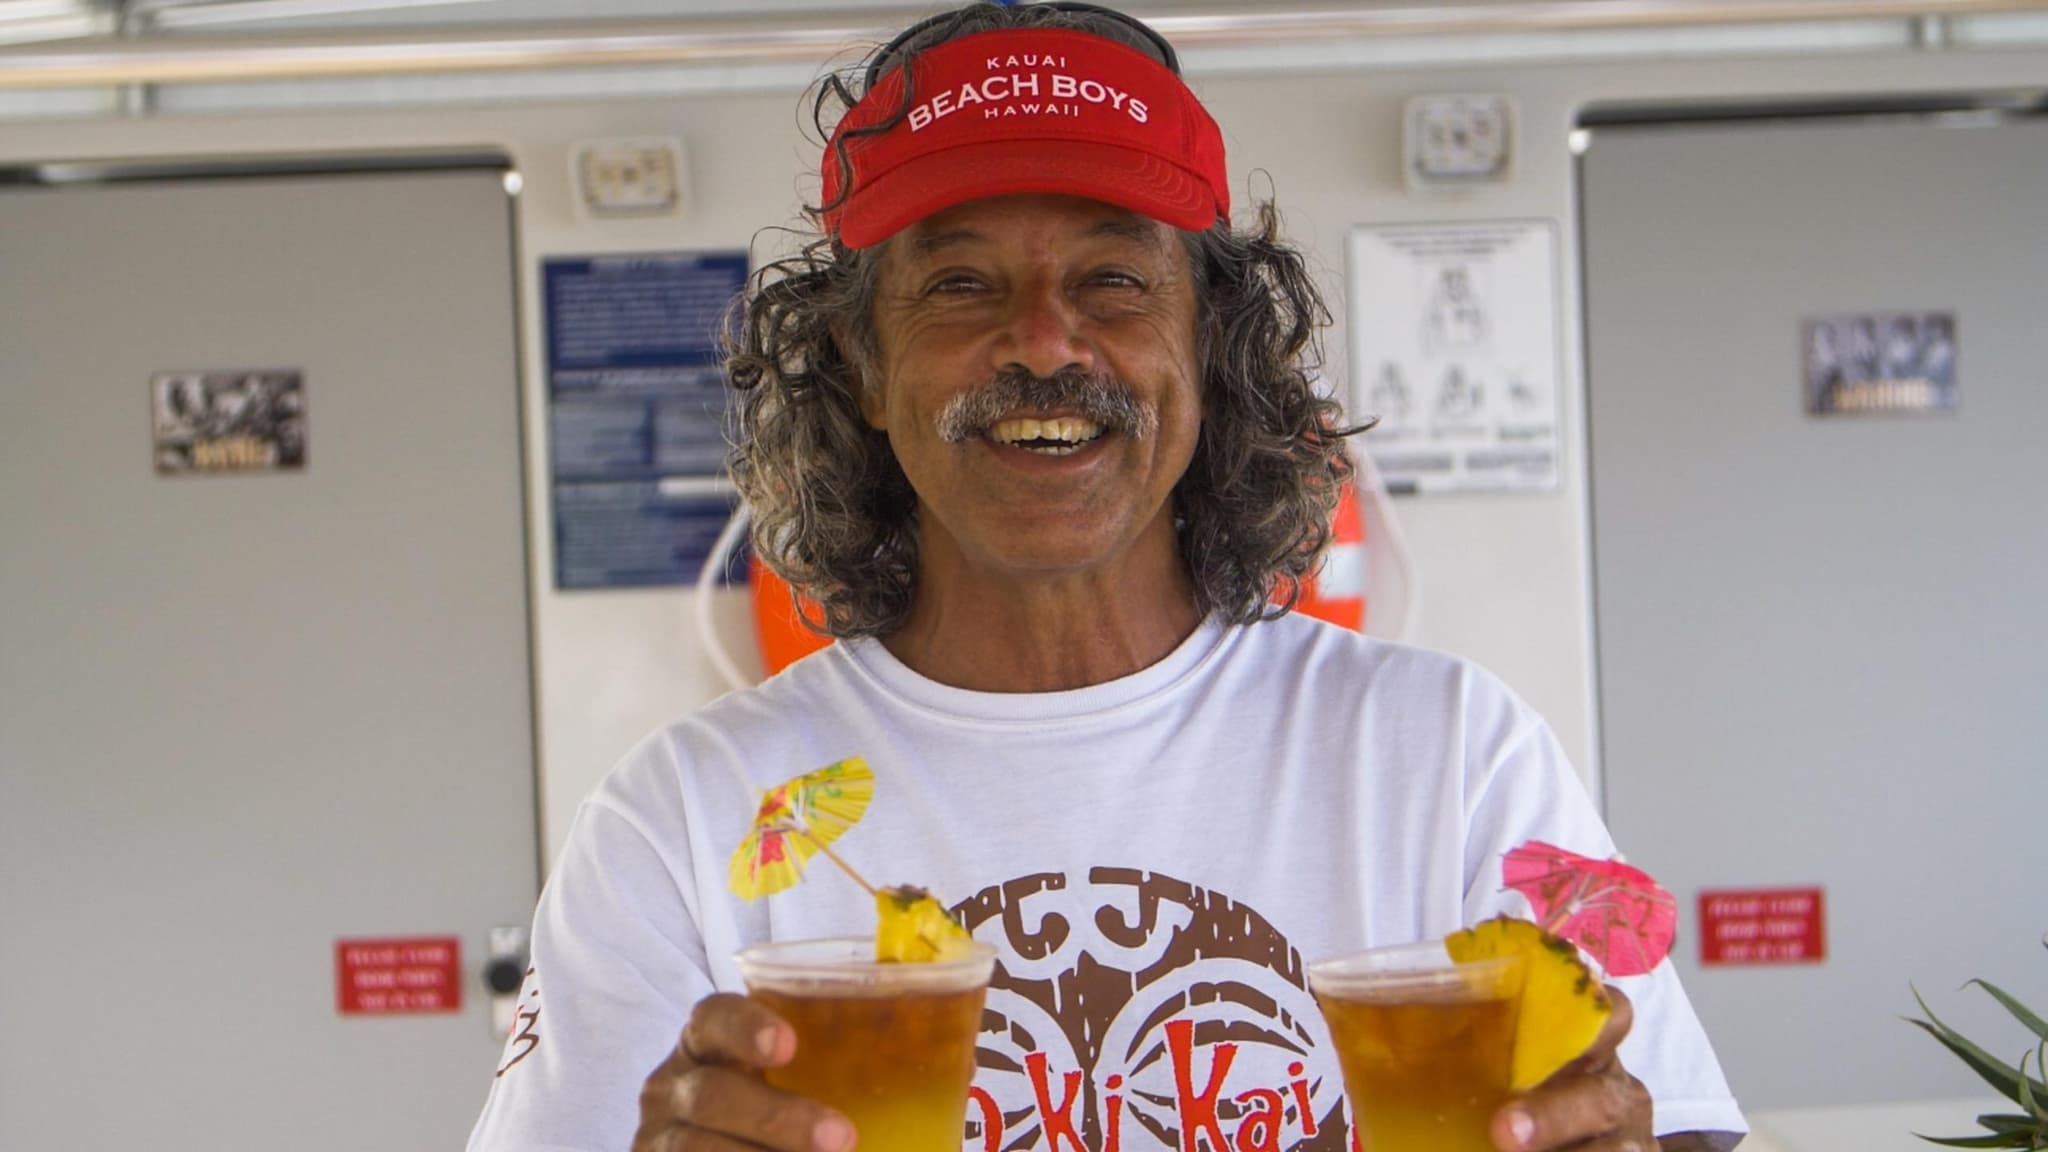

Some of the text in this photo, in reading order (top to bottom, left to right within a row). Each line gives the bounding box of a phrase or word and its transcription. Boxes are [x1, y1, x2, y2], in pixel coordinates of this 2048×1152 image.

[986, 54, 1066, 70] KAUAI
[907, 73, 1149, 132] BEACH BOYS
[984, 103, 1079, 119] HAWAII
[1165, 1020, 1318, 1152] Kai
